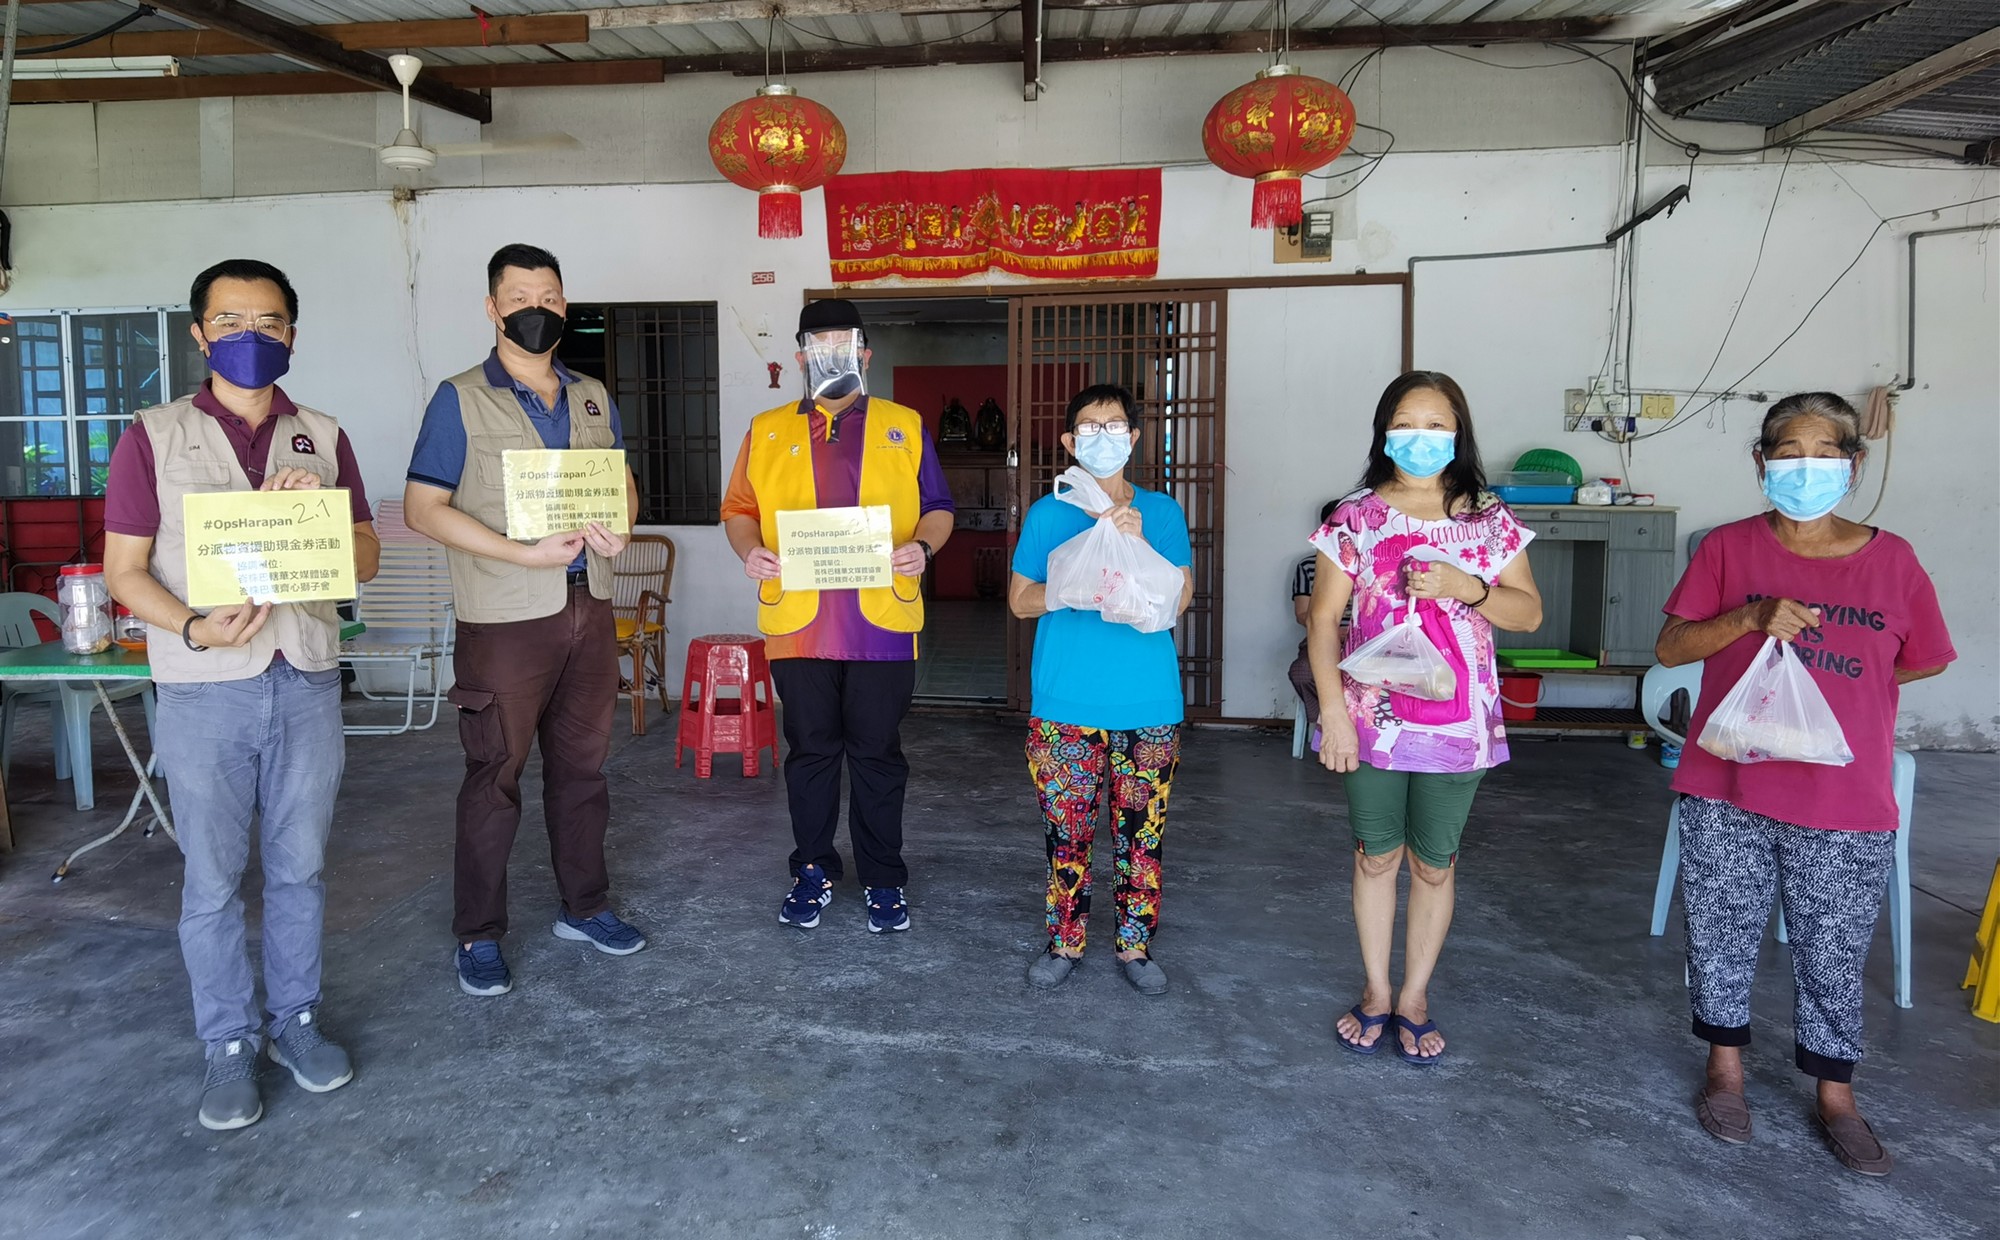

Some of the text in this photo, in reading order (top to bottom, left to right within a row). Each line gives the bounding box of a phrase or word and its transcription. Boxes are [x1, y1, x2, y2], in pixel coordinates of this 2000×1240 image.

[752, 272, 775, 283] 256
[519, 470, 587, 481] #OpsHarapan
[585, 456, 613, 478] 2.1
[292, 498, 331, 524] 2.1
[203, 516, 293, 532] #OpsHarapan
[197, 537, 341, 557] 分派物資援助現金券活動
[1800, 625, 1825, 644] IS
